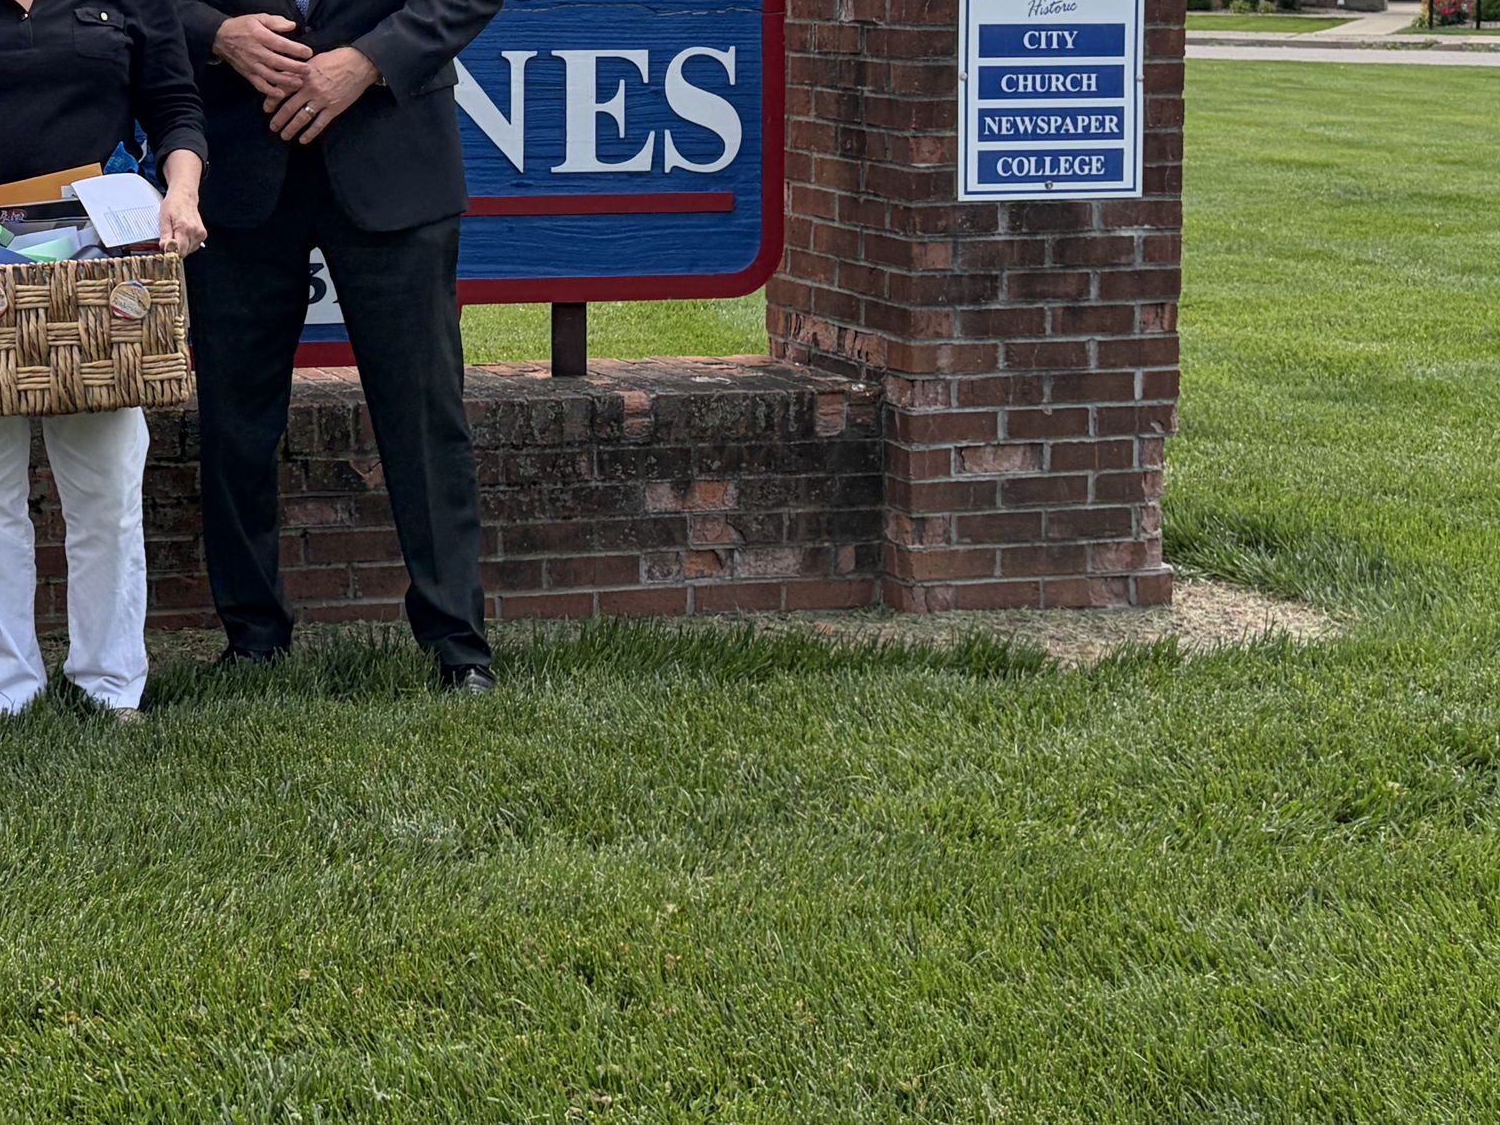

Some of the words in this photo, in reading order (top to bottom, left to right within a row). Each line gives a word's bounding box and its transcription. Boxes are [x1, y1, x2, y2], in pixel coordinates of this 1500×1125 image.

[1023, 30, 1078, 49] CITY
[1001, 73, 1098, 93] CHURCH
[983, 115, 1120, 135] NEWSPAPER
[996, 155, 1105, 177] COLLEGE
